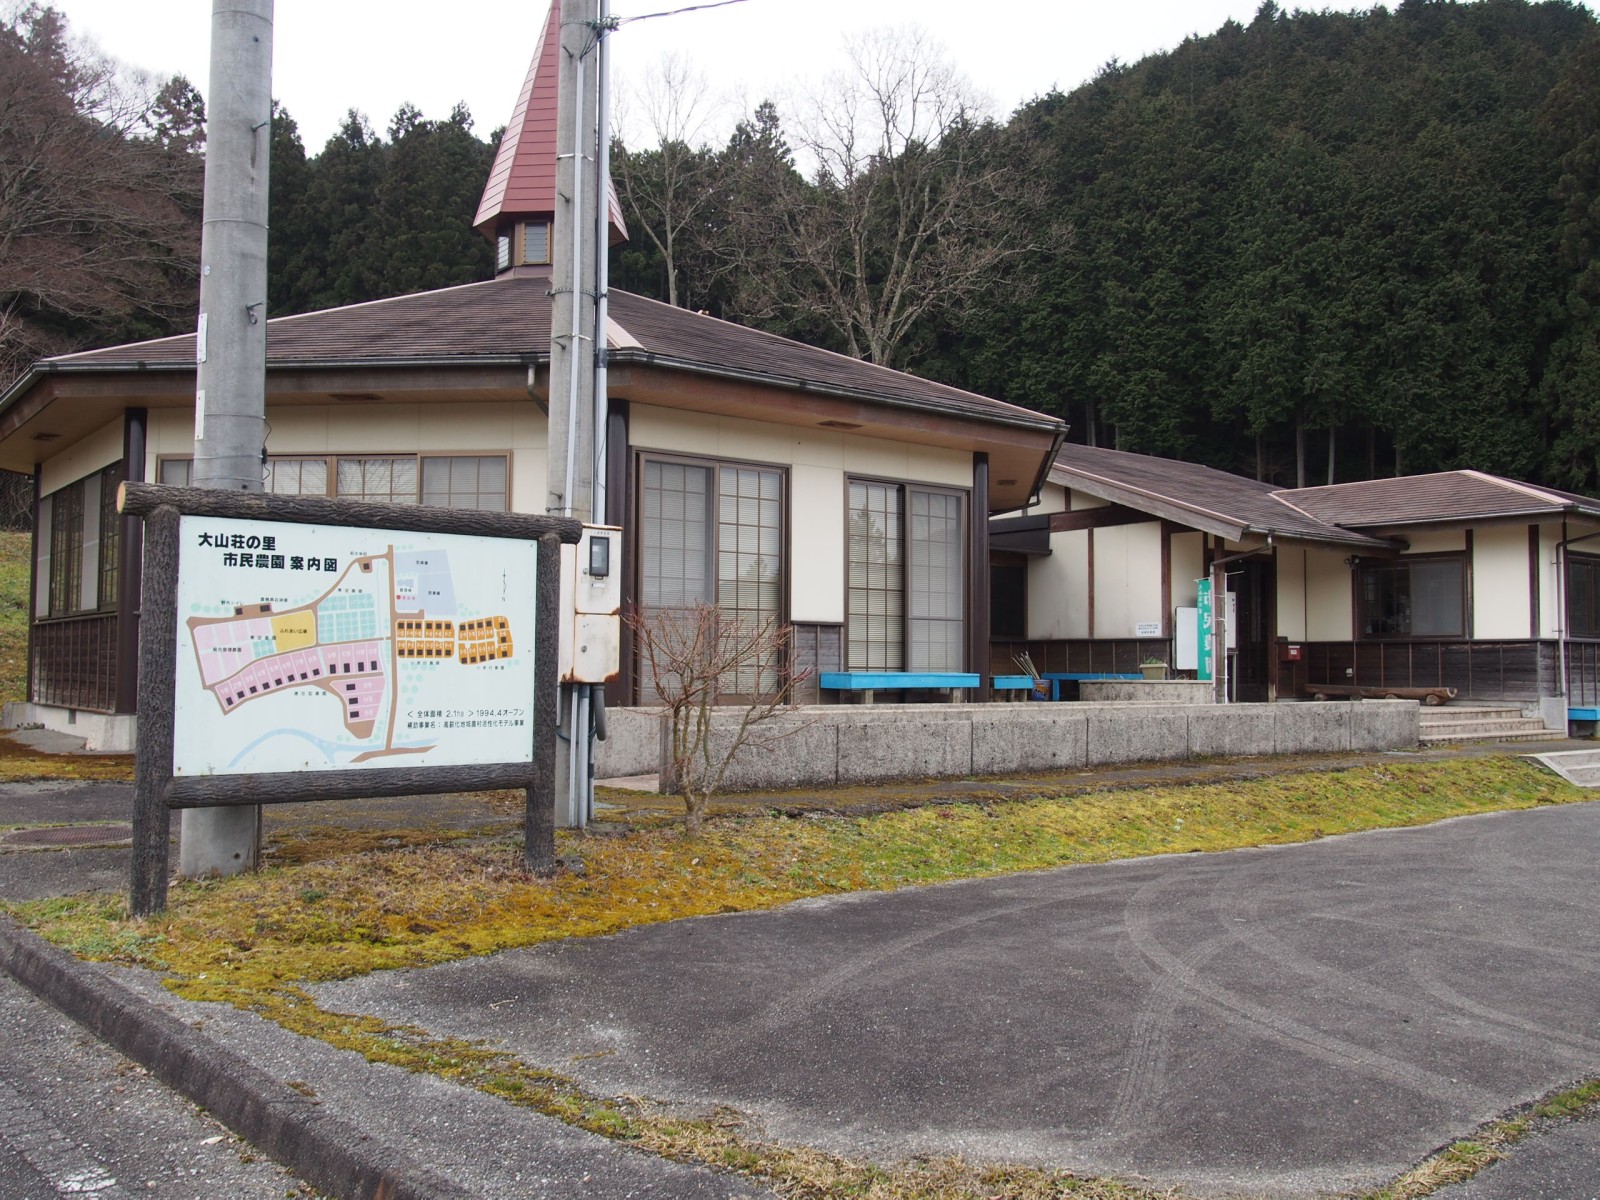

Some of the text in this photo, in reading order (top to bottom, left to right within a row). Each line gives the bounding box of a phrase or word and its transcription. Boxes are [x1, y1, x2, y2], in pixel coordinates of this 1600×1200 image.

[198, 532, 276, 551] 大山荘の里
[223, 552, 338, 572] 市民農園 案内図
[417, 710, 442, 718] 全体面積
[476, 708, 525, 717] 1994.4オープン
